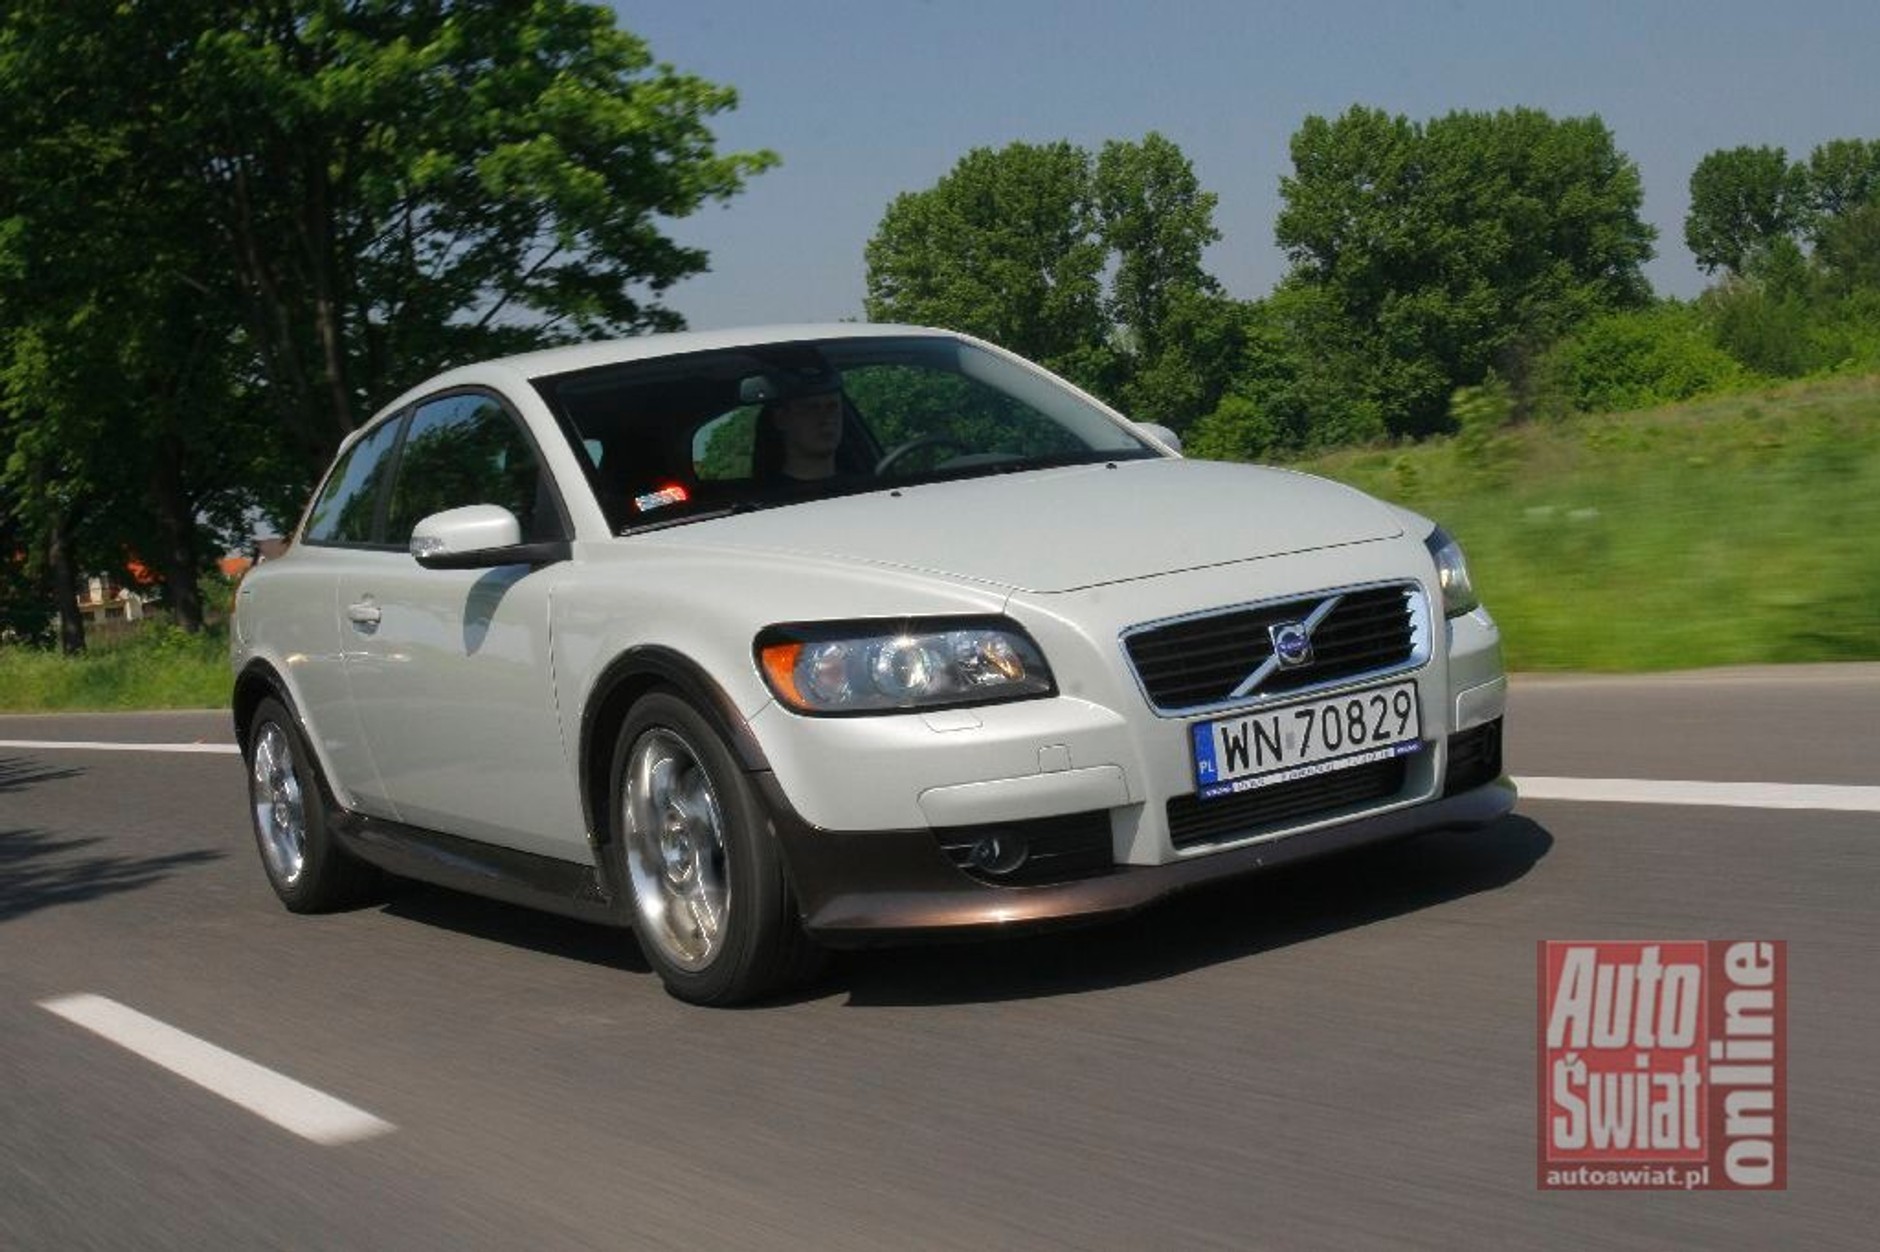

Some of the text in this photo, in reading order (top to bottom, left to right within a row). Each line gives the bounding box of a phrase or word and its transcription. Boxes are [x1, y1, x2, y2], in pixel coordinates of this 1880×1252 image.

[1221, 690, 1411, 773] WN 70829
[1199, 760, 1215, 774] PL
